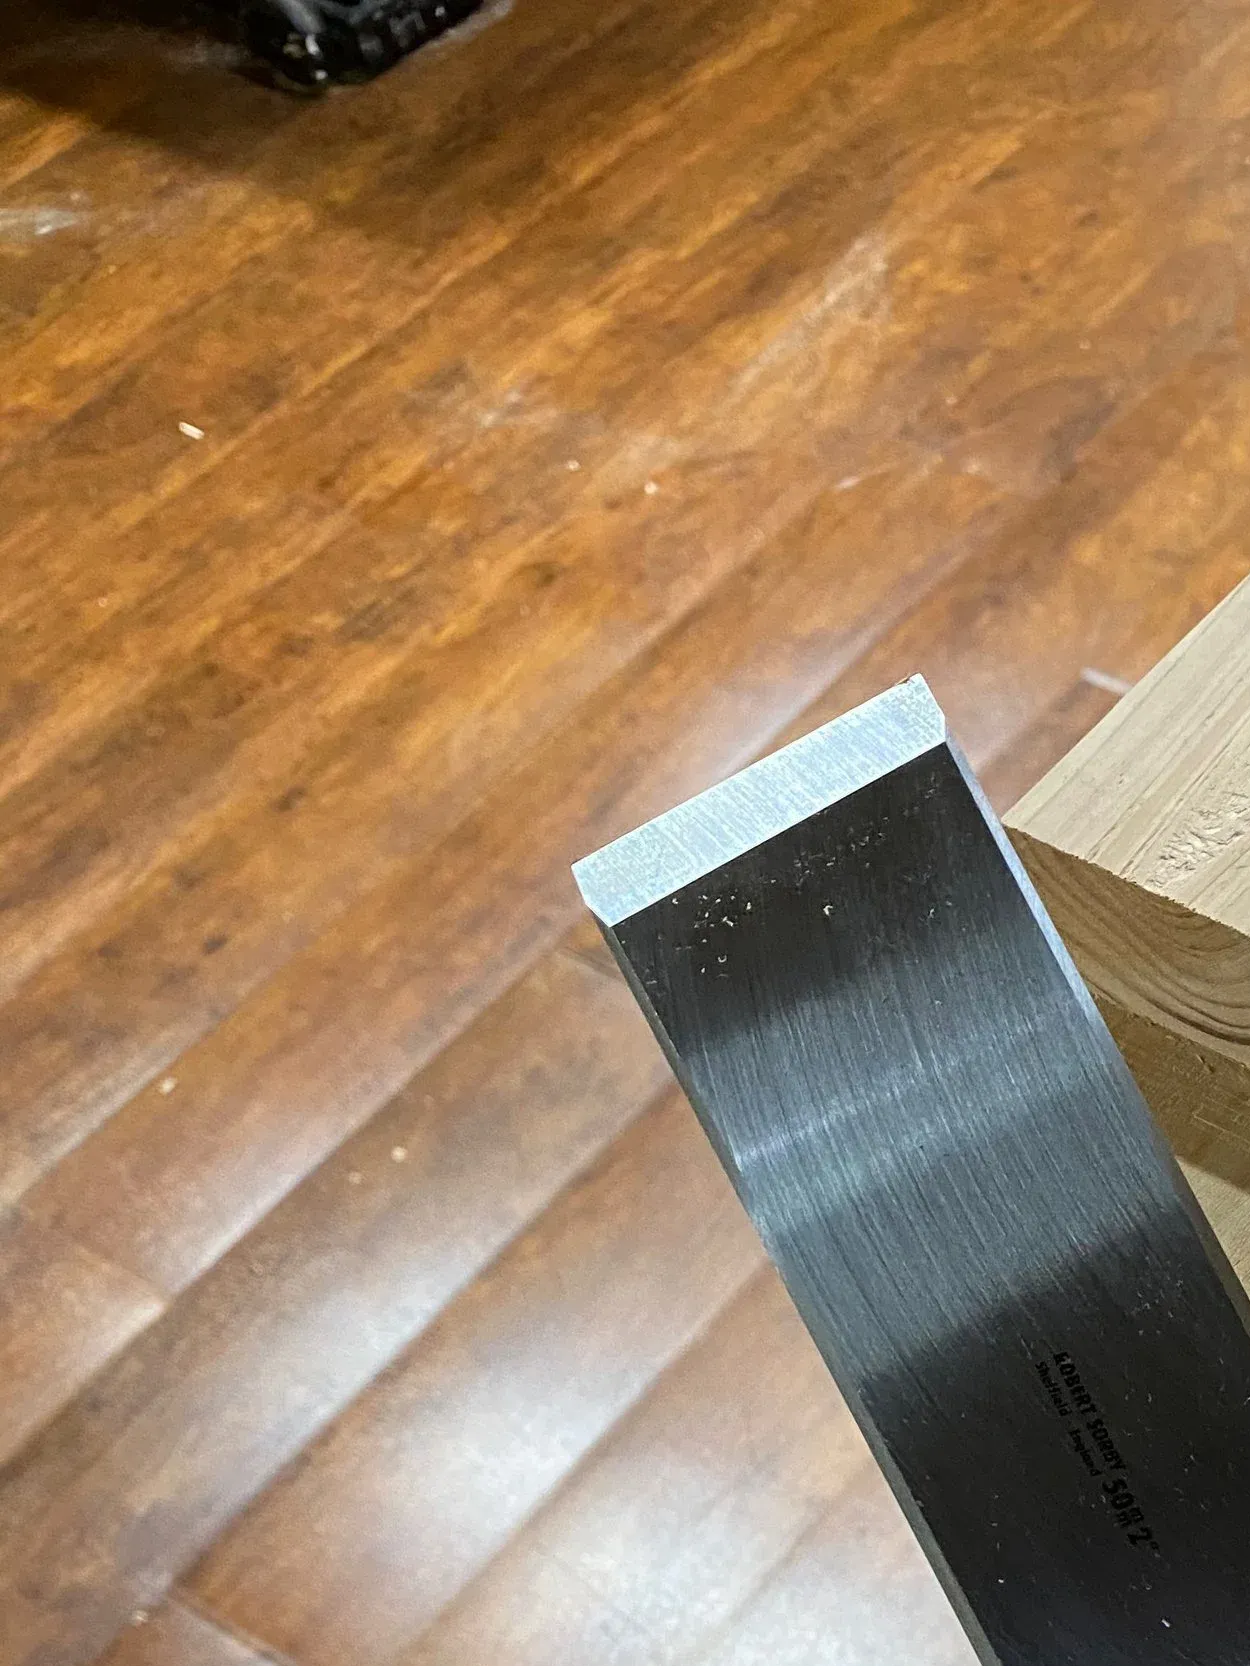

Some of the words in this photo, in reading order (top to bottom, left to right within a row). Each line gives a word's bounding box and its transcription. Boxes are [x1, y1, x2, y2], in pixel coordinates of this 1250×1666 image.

[1035, 1361, 1072, 1416] Sheffield
[1053, 1352, 1097, 1415] ROBERT
[1087, 1418, 1126, 1471] SORBY
